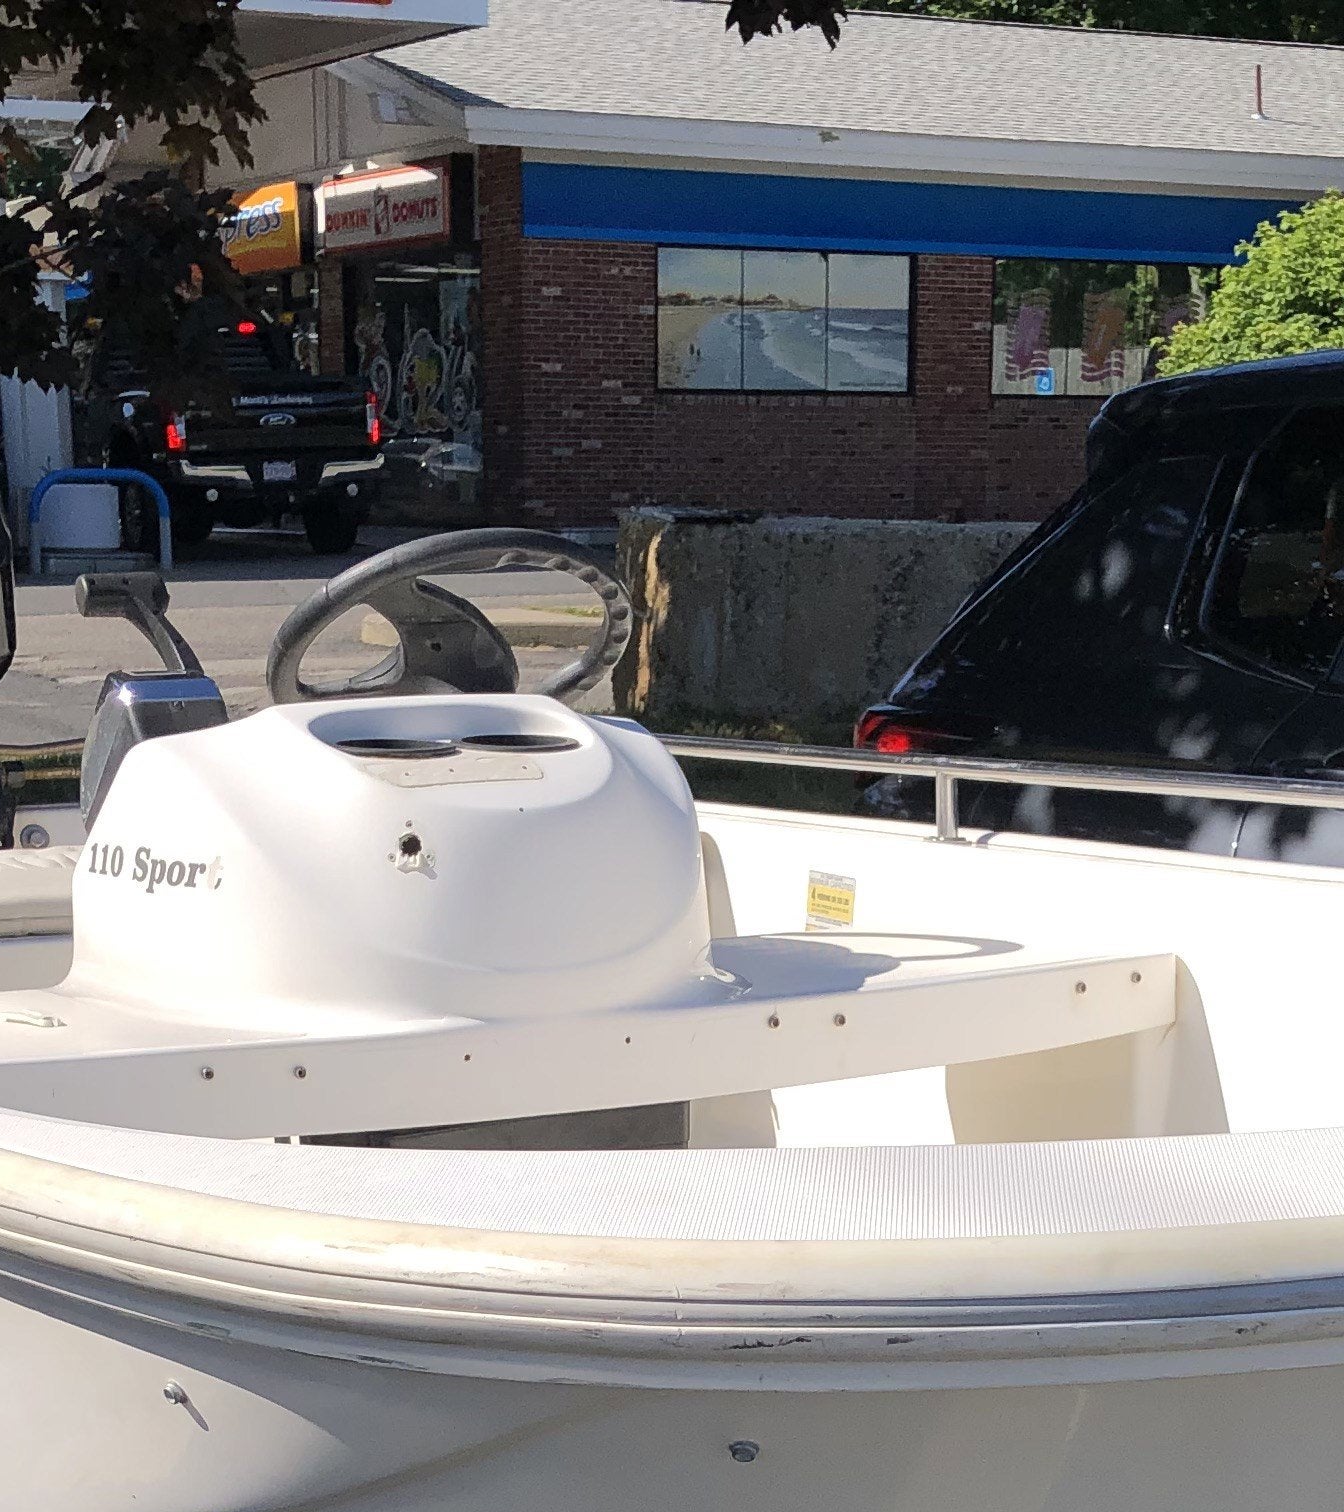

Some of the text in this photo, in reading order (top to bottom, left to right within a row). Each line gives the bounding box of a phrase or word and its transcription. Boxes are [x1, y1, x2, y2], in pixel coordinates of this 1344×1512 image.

[217, 197, 284, 256] press
[392, 196, 438, 224] DONUTS
[88, 842, 124, 878] 110
